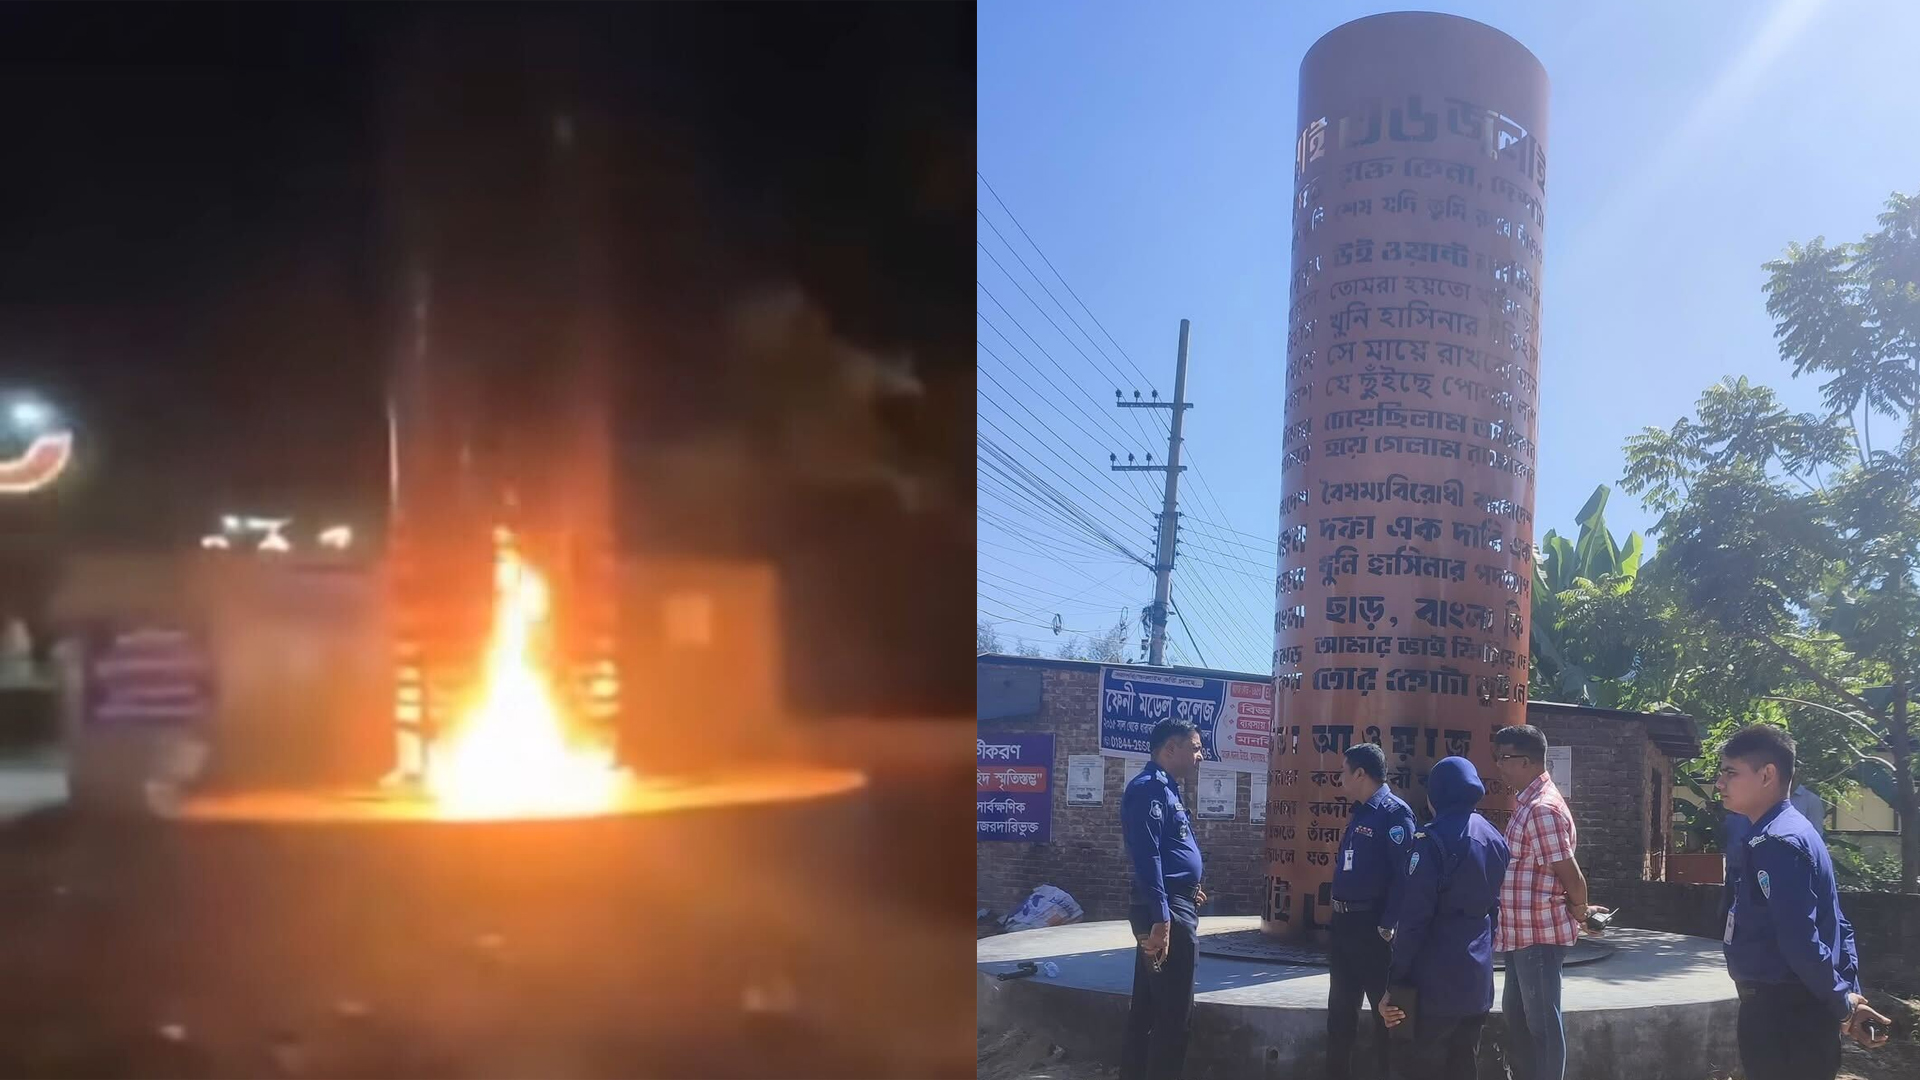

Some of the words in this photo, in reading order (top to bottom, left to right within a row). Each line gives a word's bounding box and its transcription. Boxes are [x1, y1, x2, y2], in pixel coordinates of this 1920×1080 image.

[1330, 276, 1396, 300] তোমরা
[1404, 277, 1471, 300] হয়তো
[1329, 301, 1371, 338] খুনি
[1377, 300, 1478, 336] হাসিনার
[1327, 341, 1356, 366] সে
[1363, 340, 1429, 362] মায়ে
[1326, 374, 1352, 396] যে
[1323, 436, 1368, 460] হয়ে
[1375, 435, 1463, 460] গেলাম
[1319, 473, 1464, 506] বৈষম্যবিরোধী
[1319, 515, 1376, 541] দফা
[1387, 515, 1443, 541] এক
[1367, 545, 1467, 581] হাসিনার
[1326, 596, 1398, 630] ছাড়,
[1314, 636, 1393, 658] আমার
[1397, 636, 1446, 657] ভাই
[1312, 667, 1379, 697] তোর
[1105, 681, 1137, 716] ফেনী
[1138, 693, 1174, 718] মডেল
[1176, 697, 1217, 725] কলেজ
[977, 797, 1026, 814] সার্বক্ষণিক
[1307, 821, 1341, 843] তাঁরা
